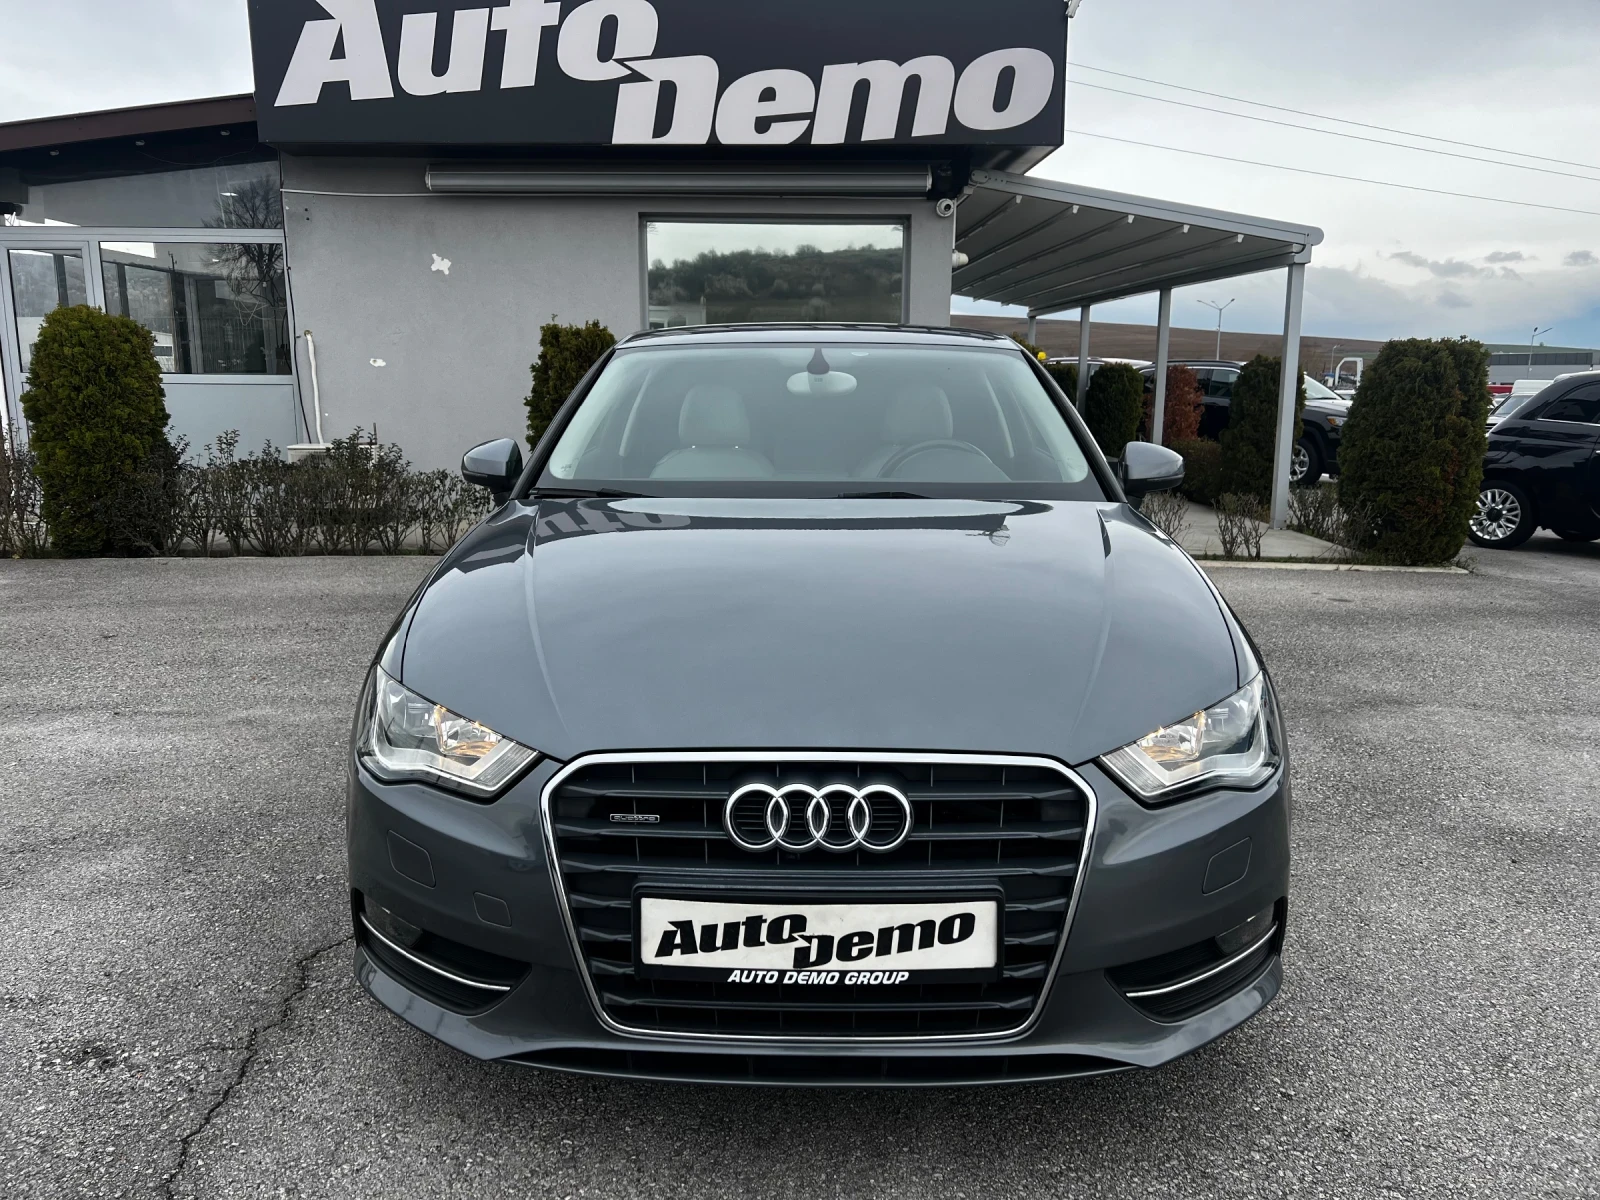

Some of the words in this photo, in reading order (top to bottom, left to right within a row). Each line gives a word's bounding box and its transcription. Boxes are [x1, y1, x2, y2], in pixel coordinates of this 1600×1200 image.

[274, 0, 659, 107] Auto
[611, 47, 1055, 145] Demo
[654, 913, 808, 958] Auto
[793, 912, 976, 969] Demo
[727, 969, 779, 984] AUTO
[782, 971, 840, 985] DEMO
[844, 971, 910, 985] GROUP
